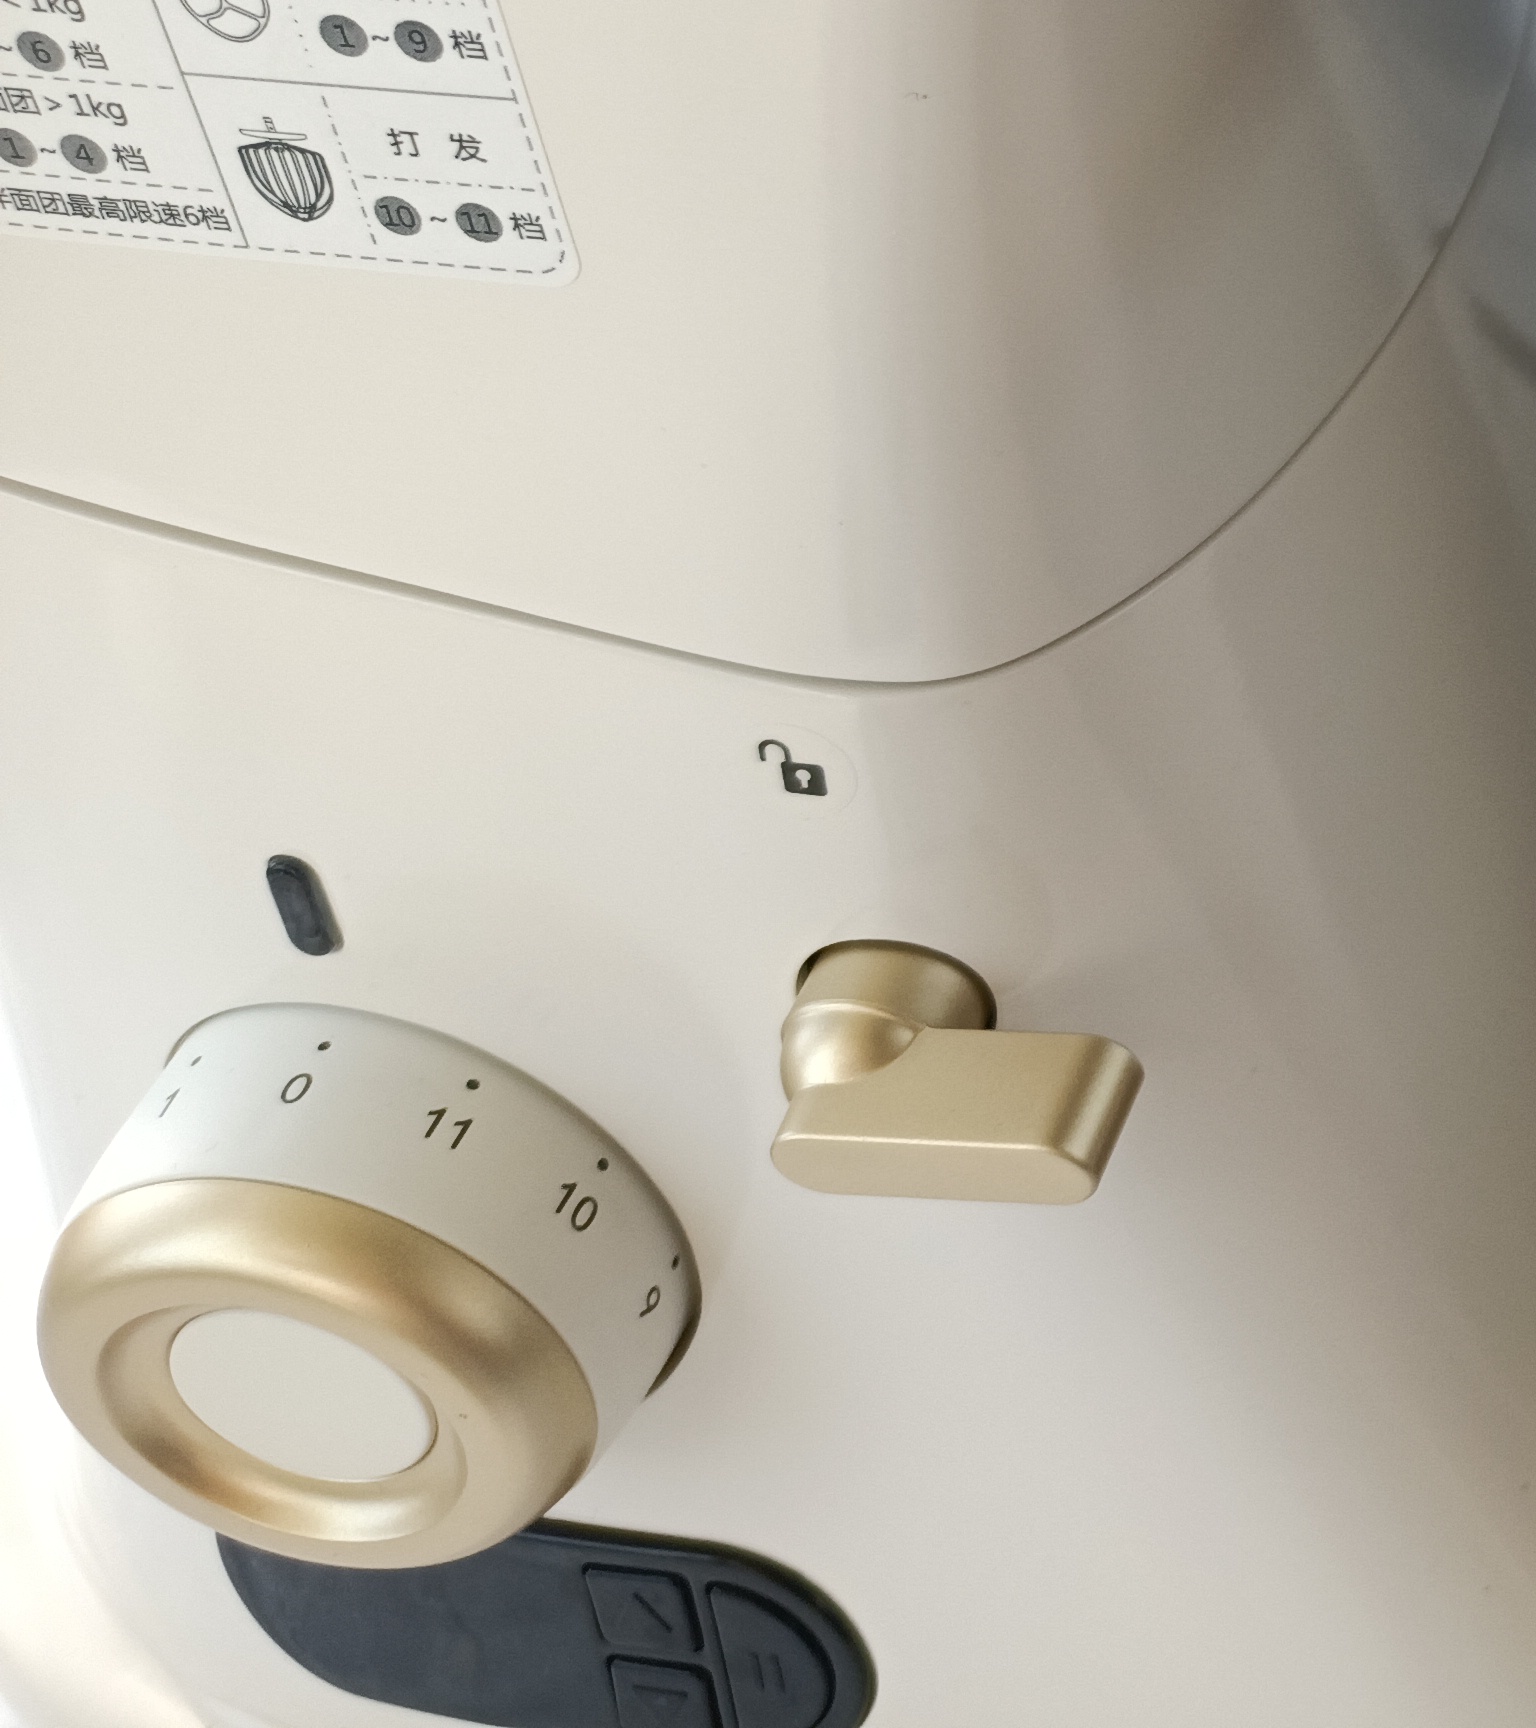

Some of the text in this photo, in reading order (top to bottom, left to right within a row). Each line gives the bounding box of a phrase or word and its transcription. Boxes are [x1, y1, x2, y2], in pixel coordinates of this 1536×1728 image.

[0, 87, 128, 127] 团>1kg
[279, 1072, 313, 1104] 0
[424, 1106, 474, 1150] 11
[554, 1181, 598, 1232] 10
[639, 1284, 662, 1319] 9
